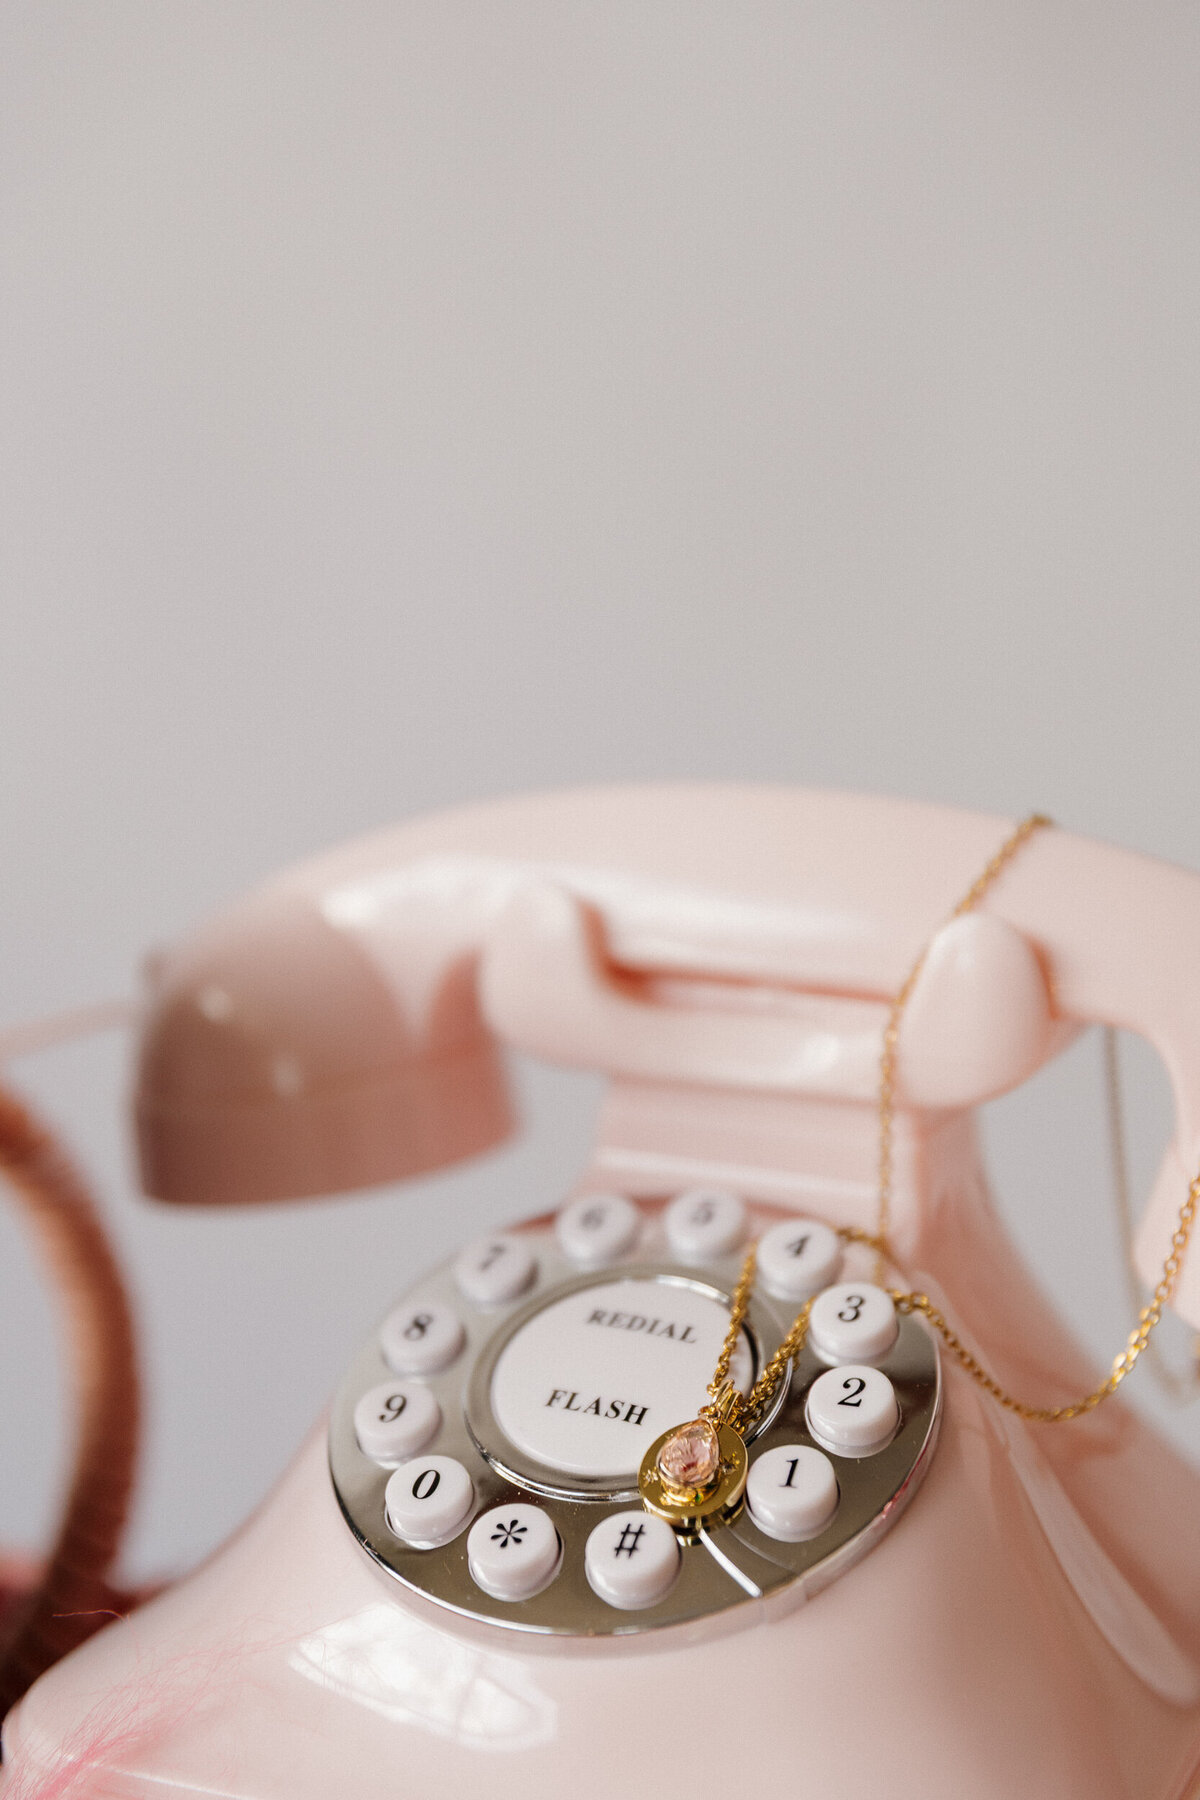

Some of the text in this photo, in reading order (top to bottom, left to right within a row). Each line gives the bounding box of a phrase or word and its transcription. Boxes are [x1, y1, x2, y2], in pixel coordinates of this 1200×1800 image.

[478, 1243, 508, 1272] 7
[785, 1233, 811, 1259] 4
[837, 1295, 866, 1323] 3
[403, 1313, 434, 1341] 8
[586, 1308, 698, 1345] REDIAL
[545, 1388, 651, 1426] FLASH
[837, 1377, 867, 1408] 2
[377, 1393, 408, 1423] 9
[411, 1469, 442, 1500] 0
[778, 1457, 801, 1489] 1
